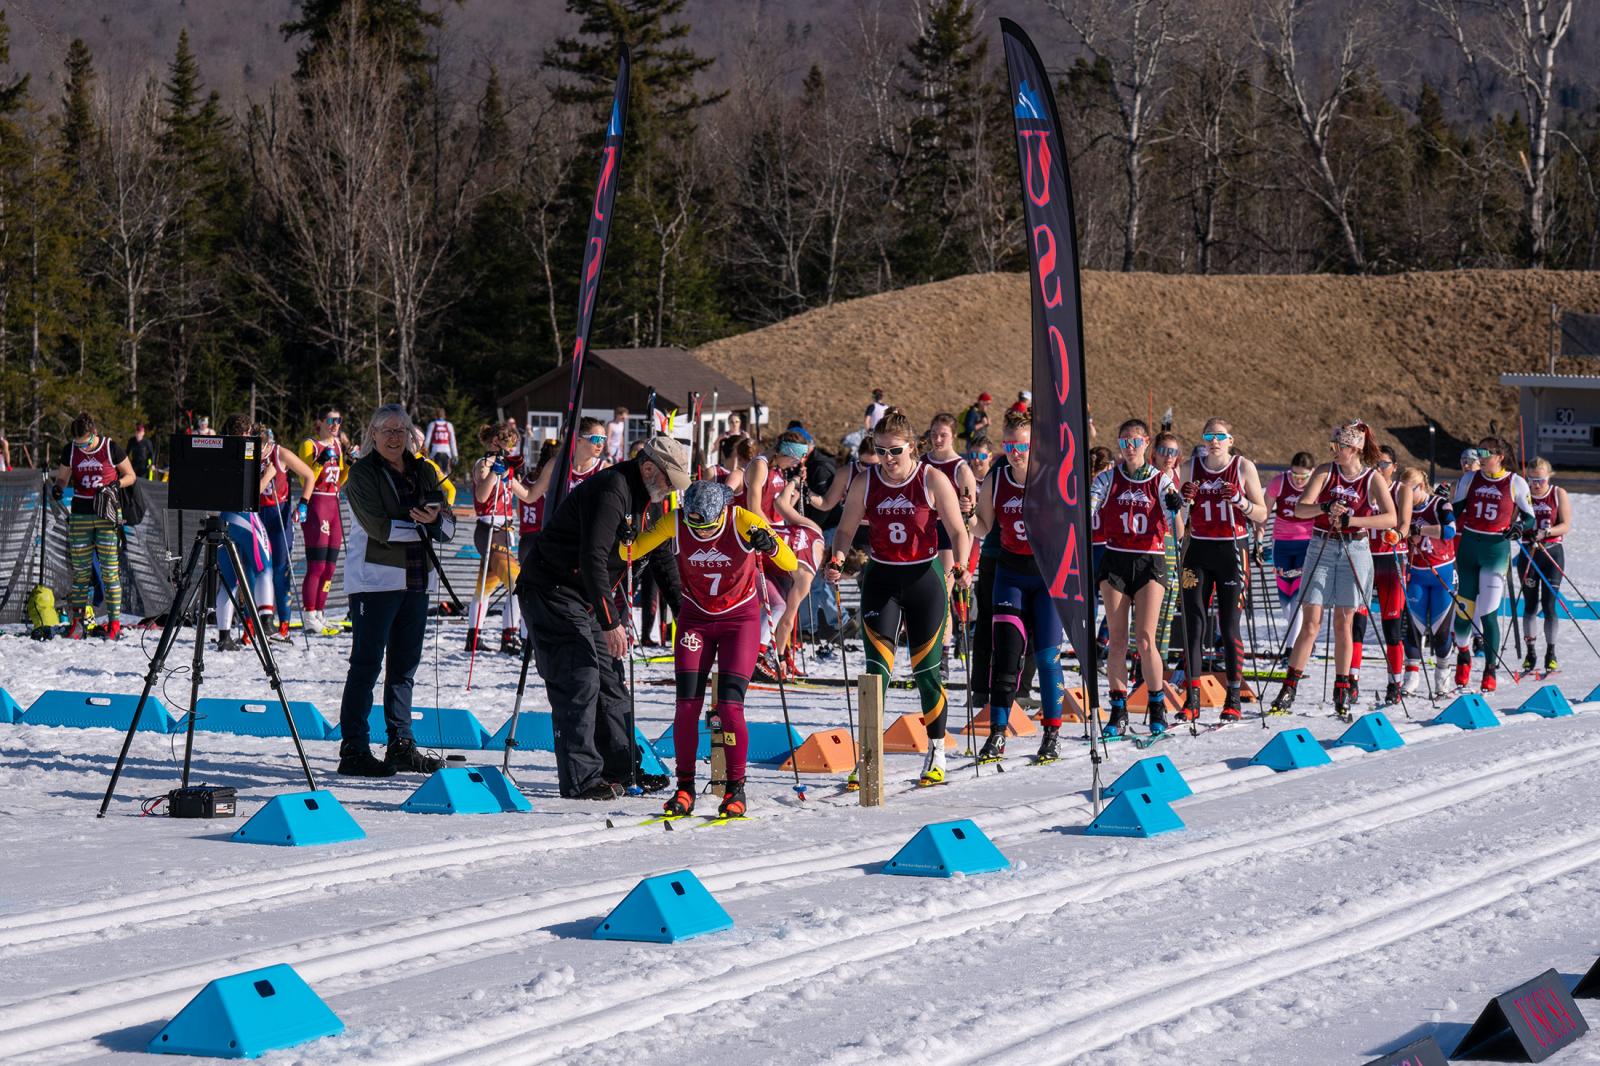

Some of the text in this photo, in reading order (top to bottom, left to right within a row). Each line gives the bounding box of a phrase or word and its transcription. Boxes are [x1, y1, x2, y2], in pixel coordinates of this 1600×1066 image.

[1558, 409, 1574, 425] 30
[81, 475, 103, 488] 42
[325, 466, 340, 483] 27
[1118, 499, 1151, 508] USCSA
[1200, 500, 1227, 521] 11
[1474, 501, 1498, 521] 15
[888, 522, 907, 544] 8
[1013, 520, 1028, 541] 9
[1119, 511, 1148, 535] 10
[703, 573, 722, 596] 7
